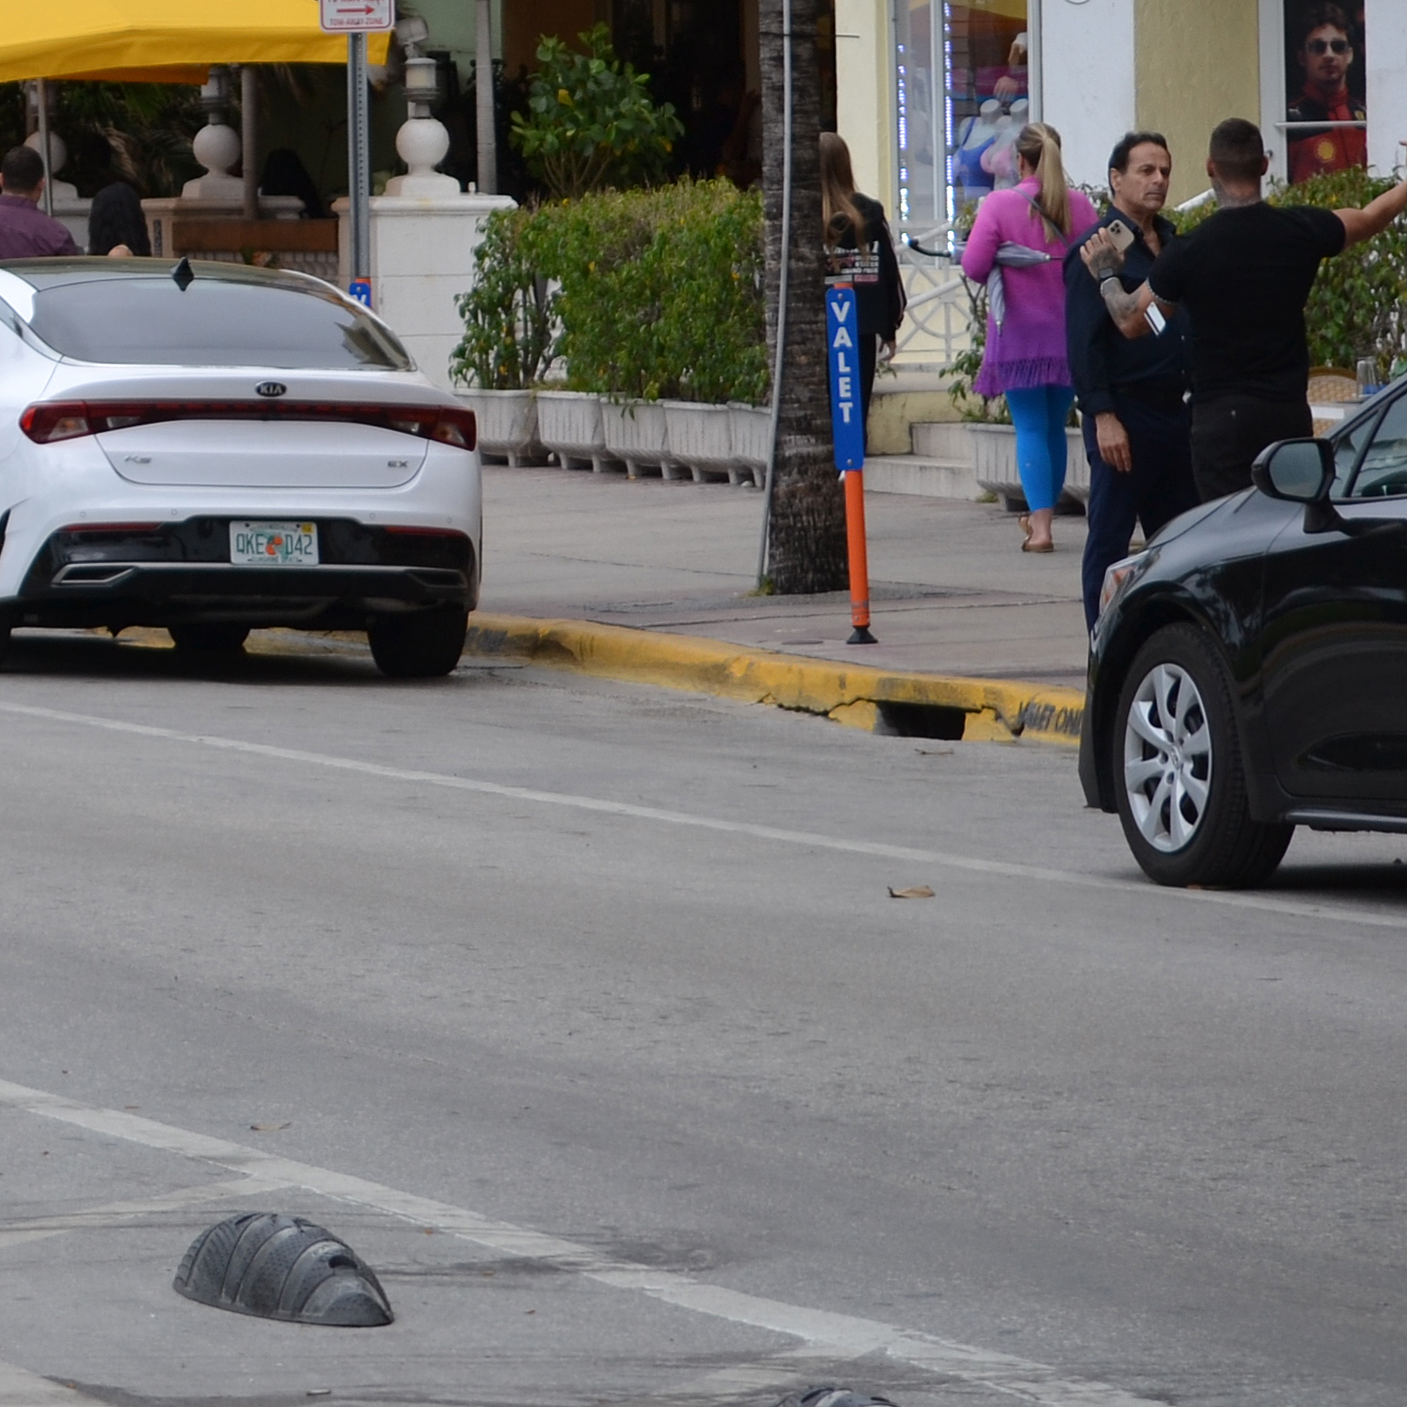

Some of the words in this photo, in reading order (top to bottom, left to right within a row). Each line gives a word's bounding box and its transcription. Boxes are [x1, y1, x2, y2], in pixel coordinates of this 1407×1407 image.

[830, 301, 854, 423] VALET
[260, 384, 283, 394] KIA
[387, 459, 409, 469] EX
[236, 533, 265, 555] QKE
[284, 533, 313, 555] D42
